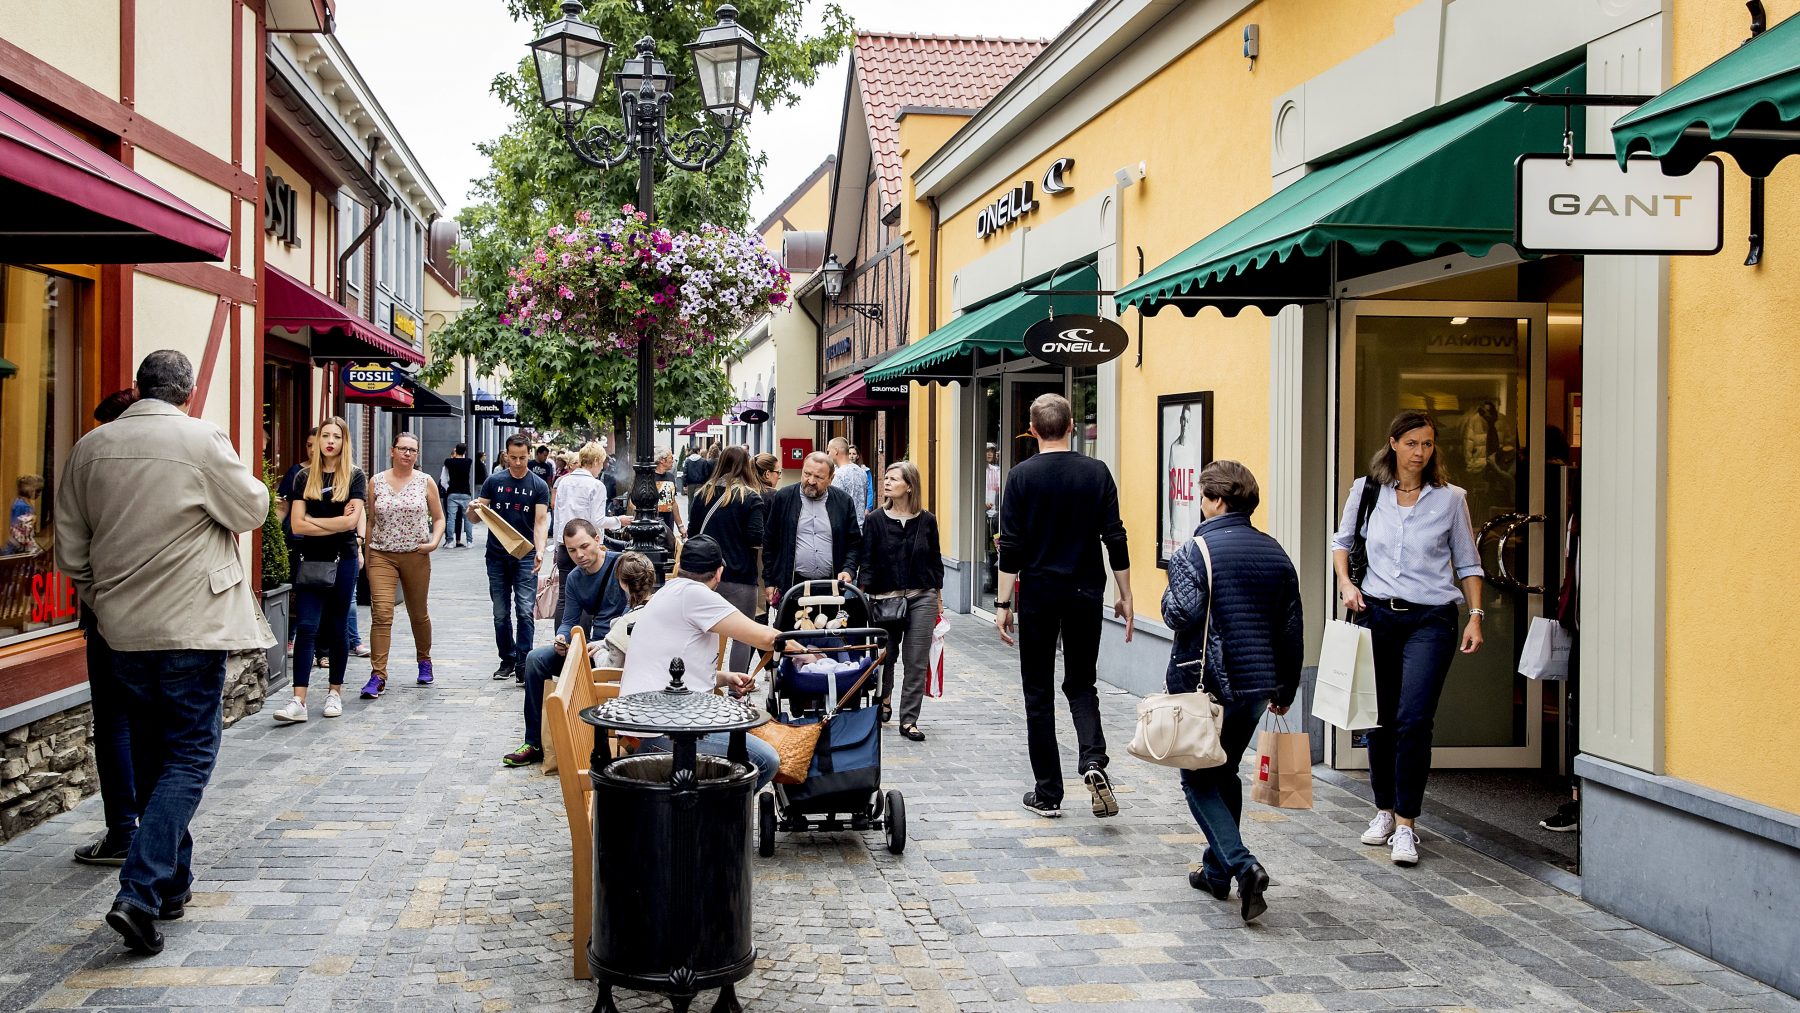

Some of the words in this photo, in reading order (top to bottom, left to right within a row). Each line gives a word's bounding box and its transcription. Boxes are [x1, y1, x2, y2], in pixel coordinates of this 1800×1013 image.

[1548, 193, 1693, 217] GANT
[1041, 342, 1111, 353] O'NEILL
[349, 371, 394, 382] FOSSIL
[1170, 467, 1194, 501] SALE
[32, 570, 76, 624] SALE
